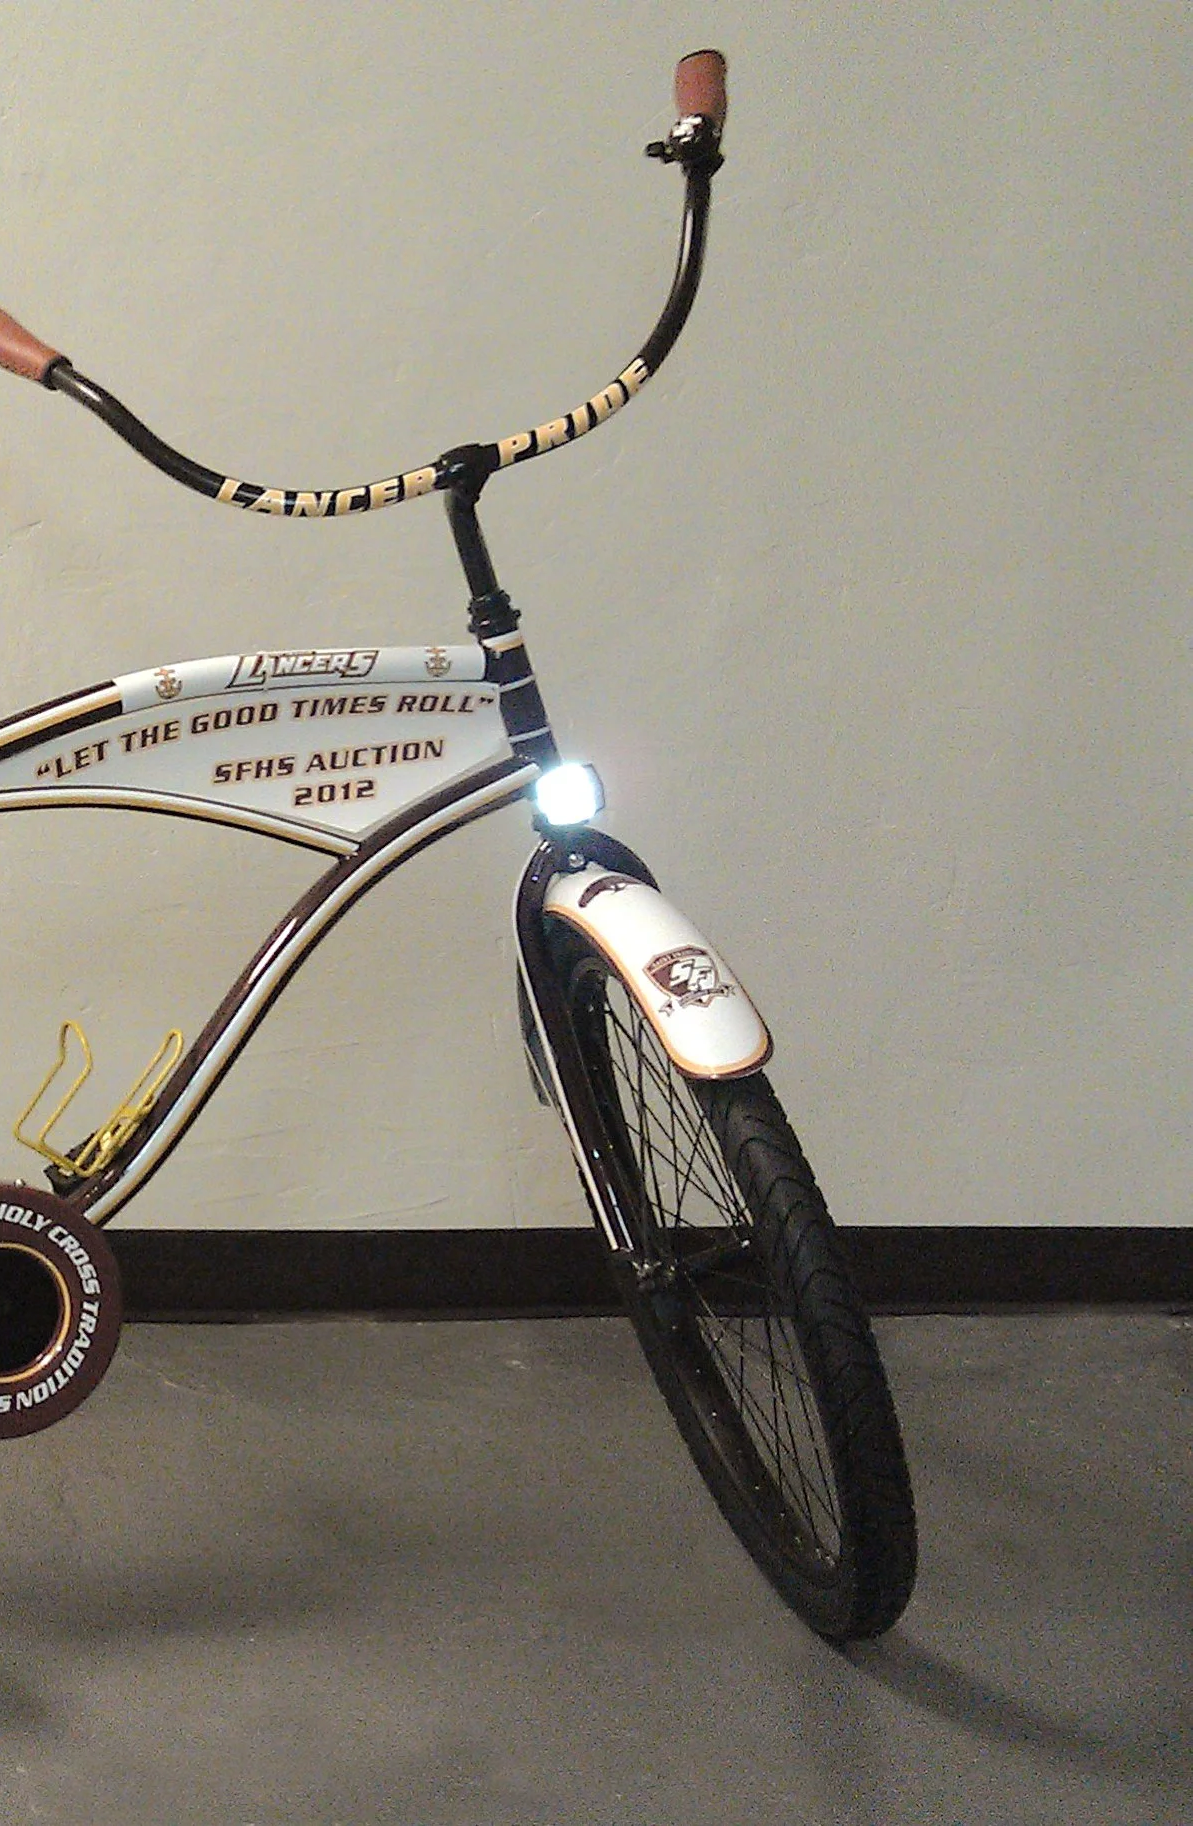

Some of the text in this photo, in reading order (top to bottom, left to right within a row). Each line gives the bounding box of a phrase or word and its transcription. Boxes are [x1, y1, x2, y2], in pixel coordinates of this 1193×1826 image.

[217, 358, 652, 517] LANCER PRIDE
[224, 649, 380, 689] LANCERS
[120, 720, 180, 752] THE
[191, 702, 279, 735] GOOD
[292, 695, 387, 719] TIMES
[213, 738, 444, 784] SFHS AUCTION
[294, 779, 375, 806] 2012
[47, 1224, 101, 1296] CROSS
[15, 1300, 101, 1411] TRADITION
